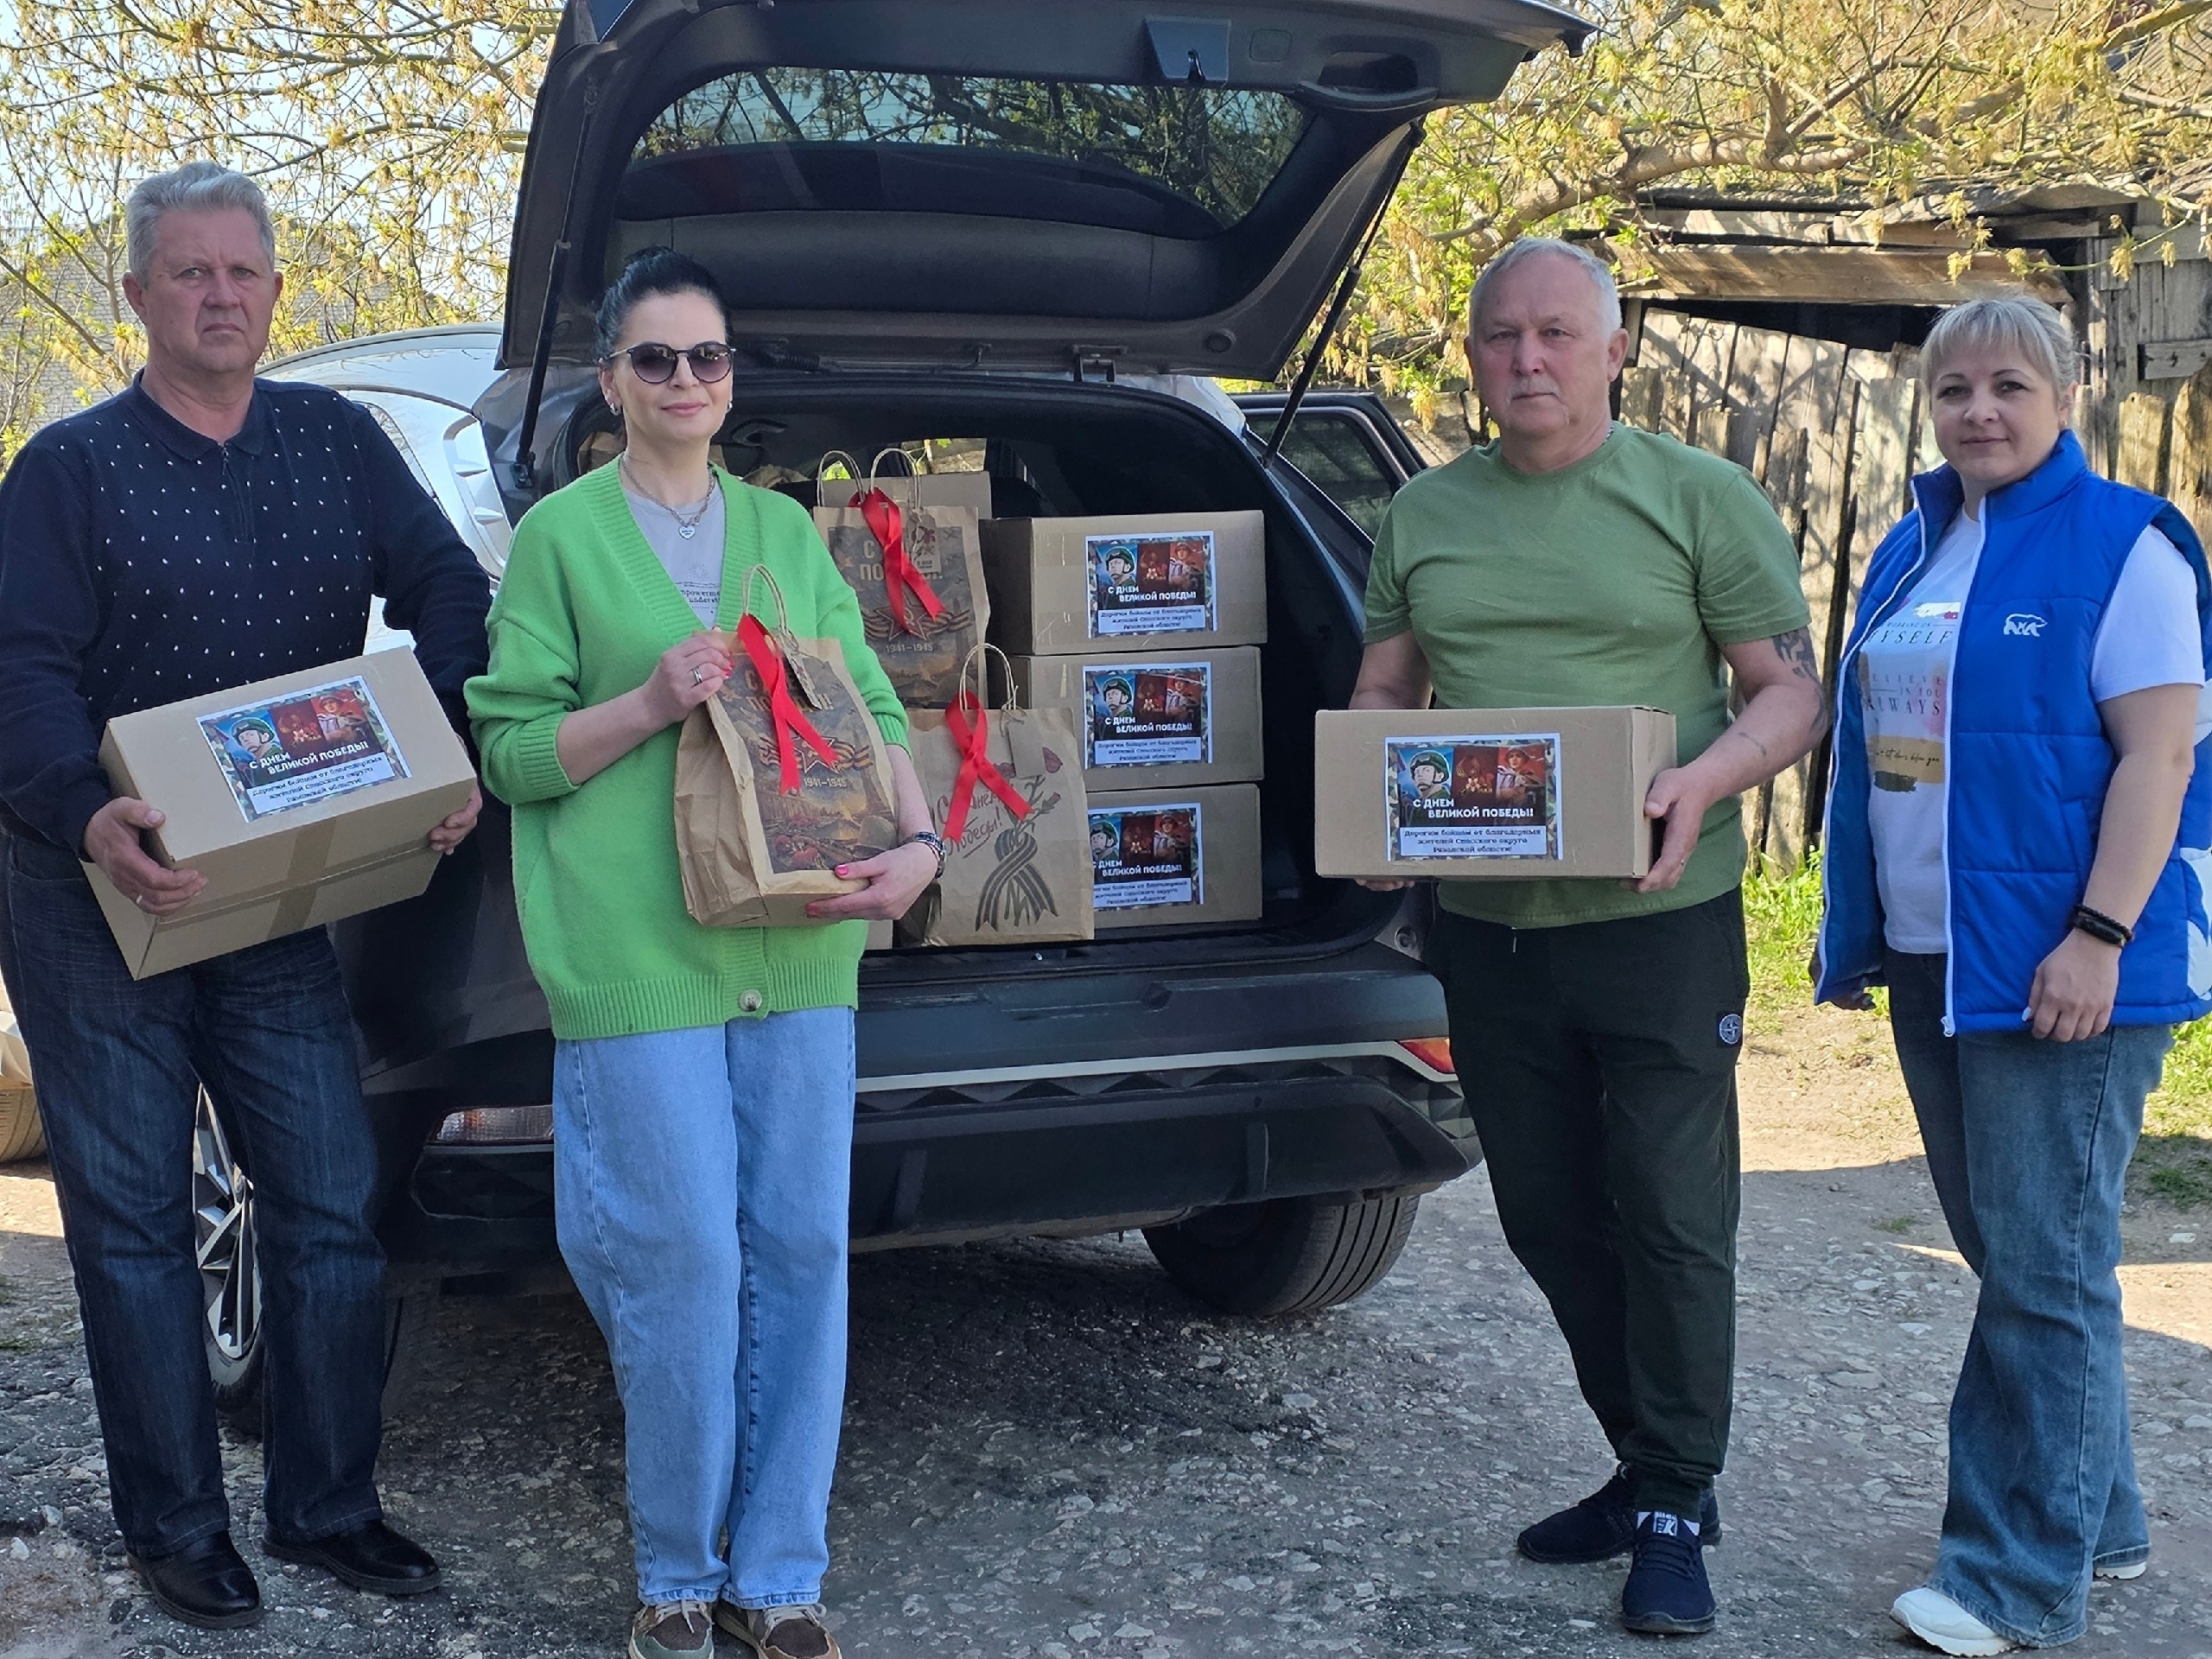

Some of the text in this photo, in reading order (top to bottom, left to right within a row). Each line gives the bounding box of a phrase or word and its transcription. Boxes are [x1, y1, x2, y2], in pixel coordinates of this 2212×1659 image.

[1119, 591, 1157, 603] ВЕЛИКОЙ
[1116, 721, 1154, 734] ВЕЛИКОЙ
[259, 752, 291, 768] ДНЕМ
[267, 741, 370, 775] ВЕЛИКОЙ ПОБЕДЫ!
[1413, 798, 1455, 810] С ДНЕМ
[1427, 805, 1535, 819] ВЕЛИКОЙ ПОБЕДЫ!
[1102, 864, 1141, 877] ВЕЛИКОЙ
